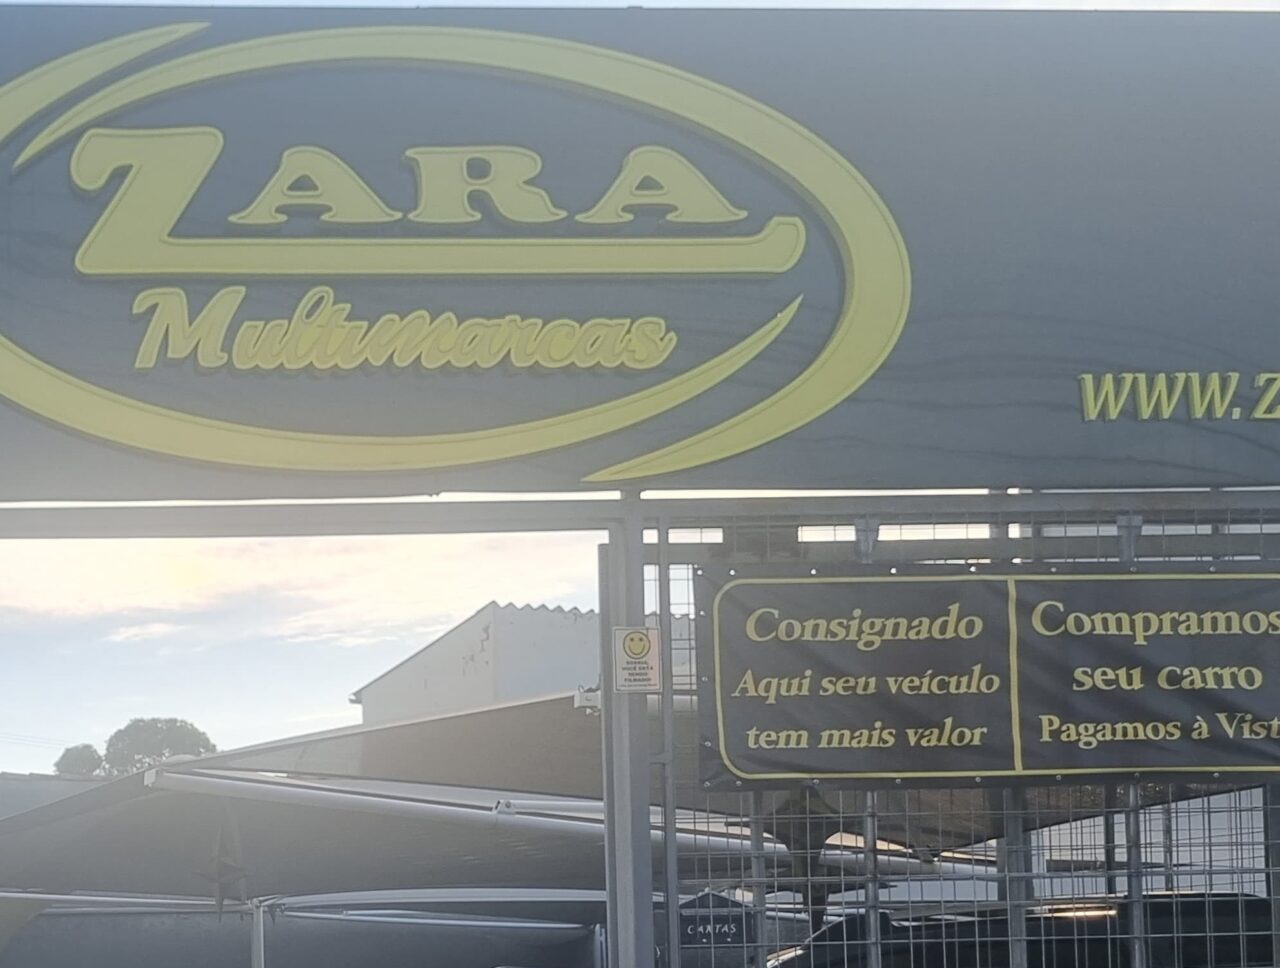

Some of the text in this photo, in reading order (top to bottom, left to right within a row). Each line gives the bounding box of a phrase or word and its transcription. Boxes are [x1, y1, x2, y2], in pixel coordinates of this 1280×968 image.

[69, 126, 806, 276] ZARA
[132, 285, 678, 370] Multimarcas
[745, 602, 984, 652] Consignado
[1031, 600, 1280, 646] Compramos
[731, 663, 1001, 704] Aqui seu veículo
[1072, 665, 1263, 691] seu carro
[746, 716, 989, 749] tem mais valor
[1038, 714, 1182, 749] Pagamos
[1191, 715, 1211, 740] à
